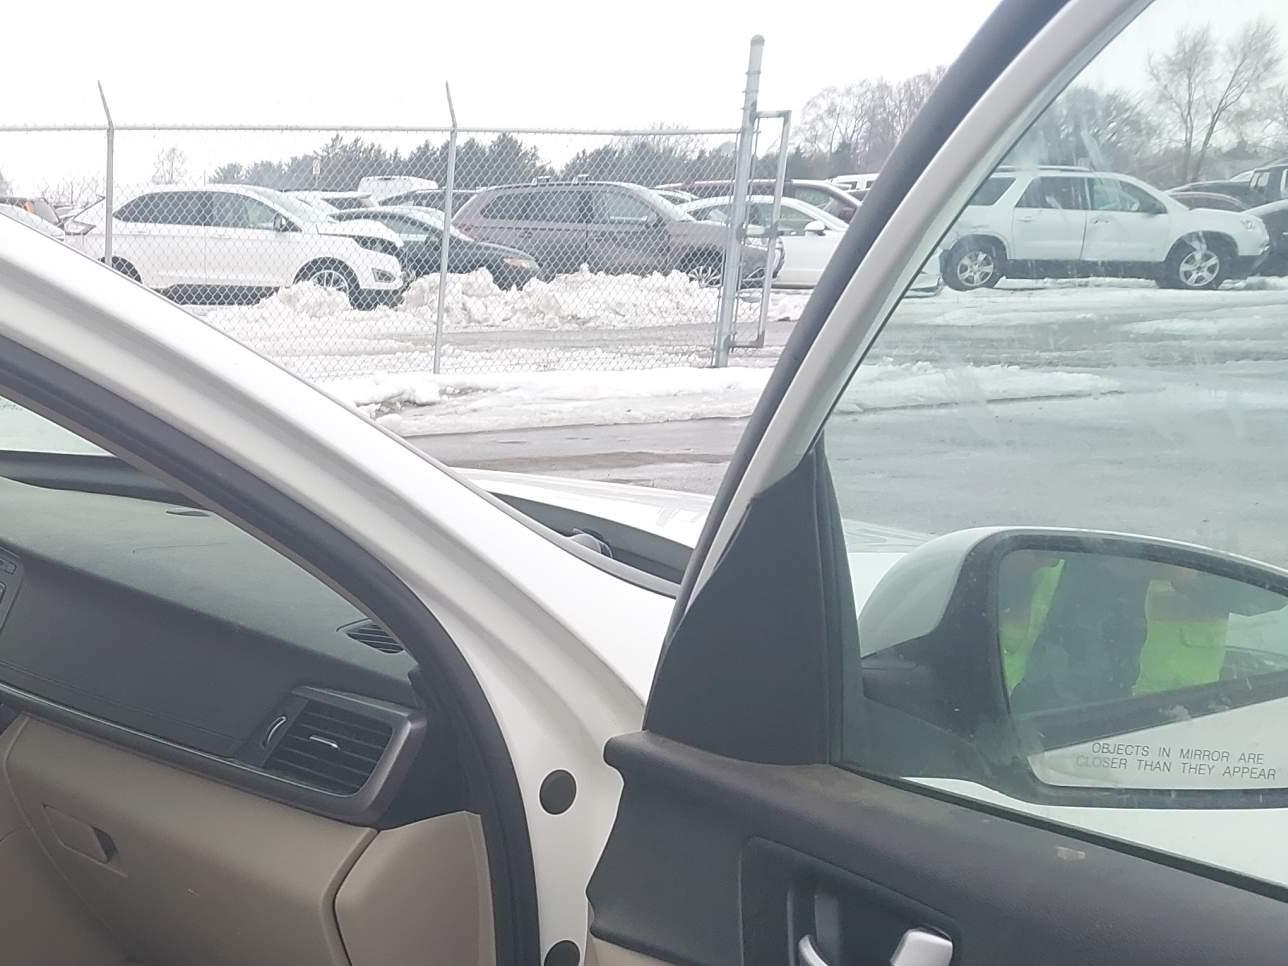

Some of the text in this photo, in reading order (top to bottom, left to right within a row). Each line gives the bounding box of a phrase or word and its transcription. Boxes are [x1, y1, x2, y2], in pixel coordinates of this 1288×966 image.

[1091, 742, 1265, 765] OBJECTS IN MIRROR ARE
[1076, 755, 1277, 780] CLOSER THAN THEY APPEAR
